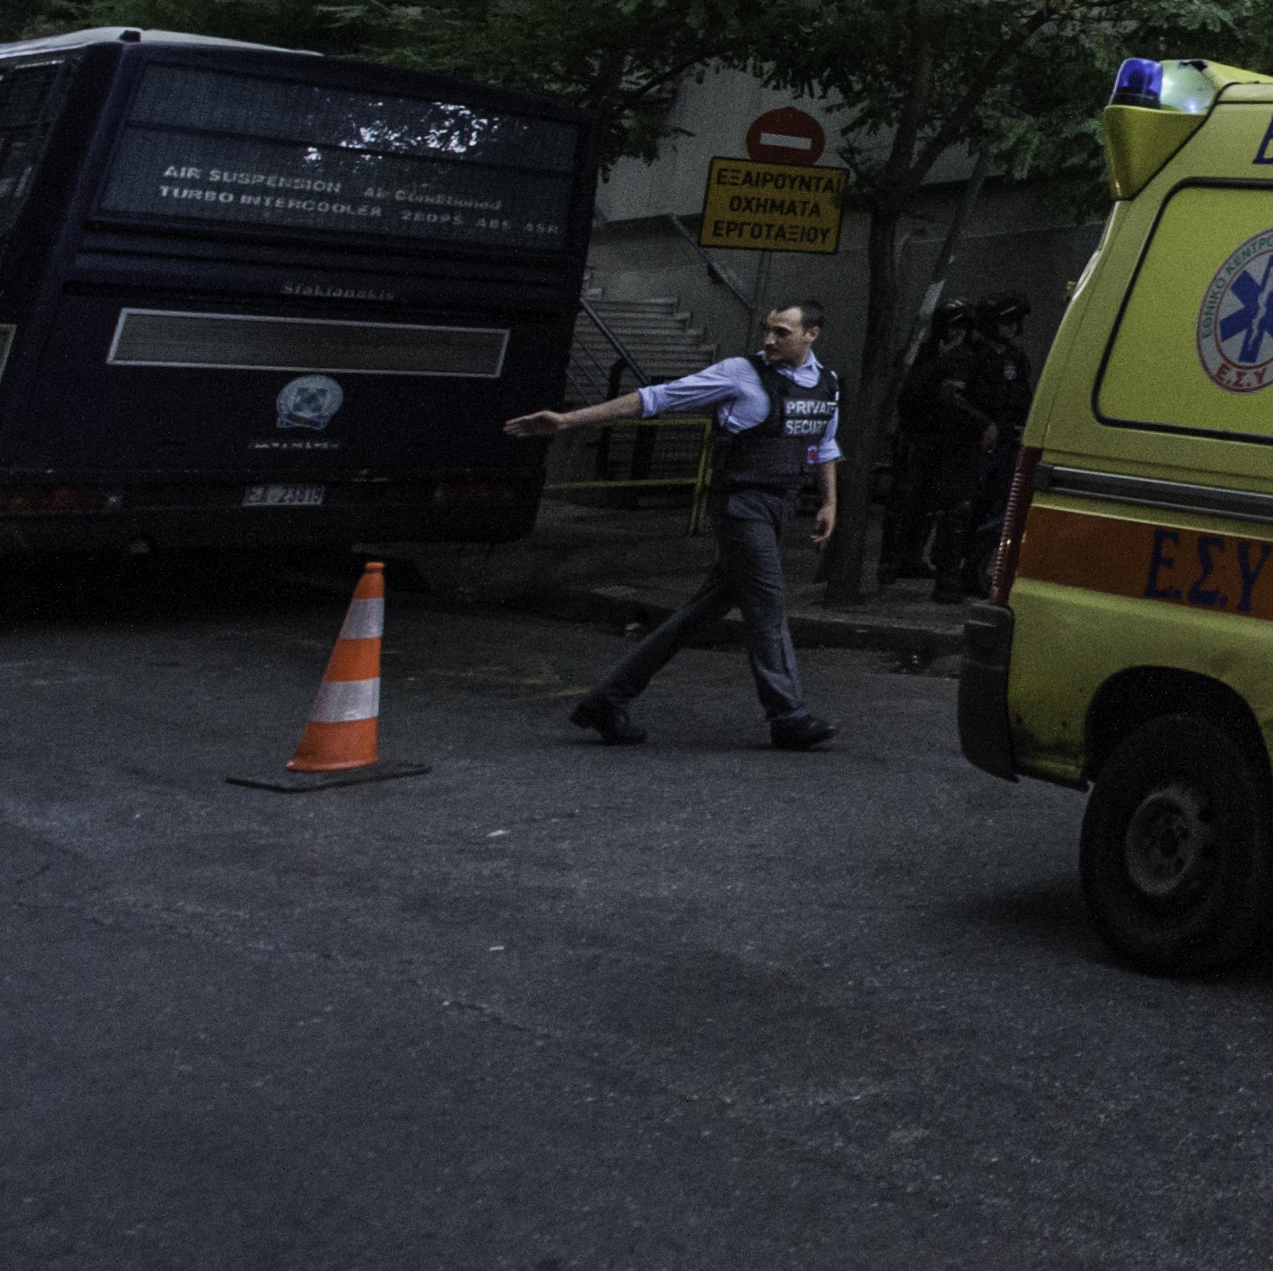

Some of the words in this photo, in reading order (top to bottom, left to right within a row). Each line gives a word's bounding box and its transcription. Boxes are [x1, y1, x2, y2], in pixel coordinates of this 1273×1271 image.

[163, 164, 201, 180] AIR
[208, 168, 343, 194] SUSPENSION
[716, 167, 842, 194] ΕΞΑΙΡΟΥΝΤΑΙ
[158, 184, 235, 204] TURBO
[239, 193, 383, 218] INTERCOOLER
[729, 195, 821, 217] ΟΧΗΜΑΤΑ
[711, 219, 831, 244] ΕΡΓΟΤΑΞΙΟΥ
